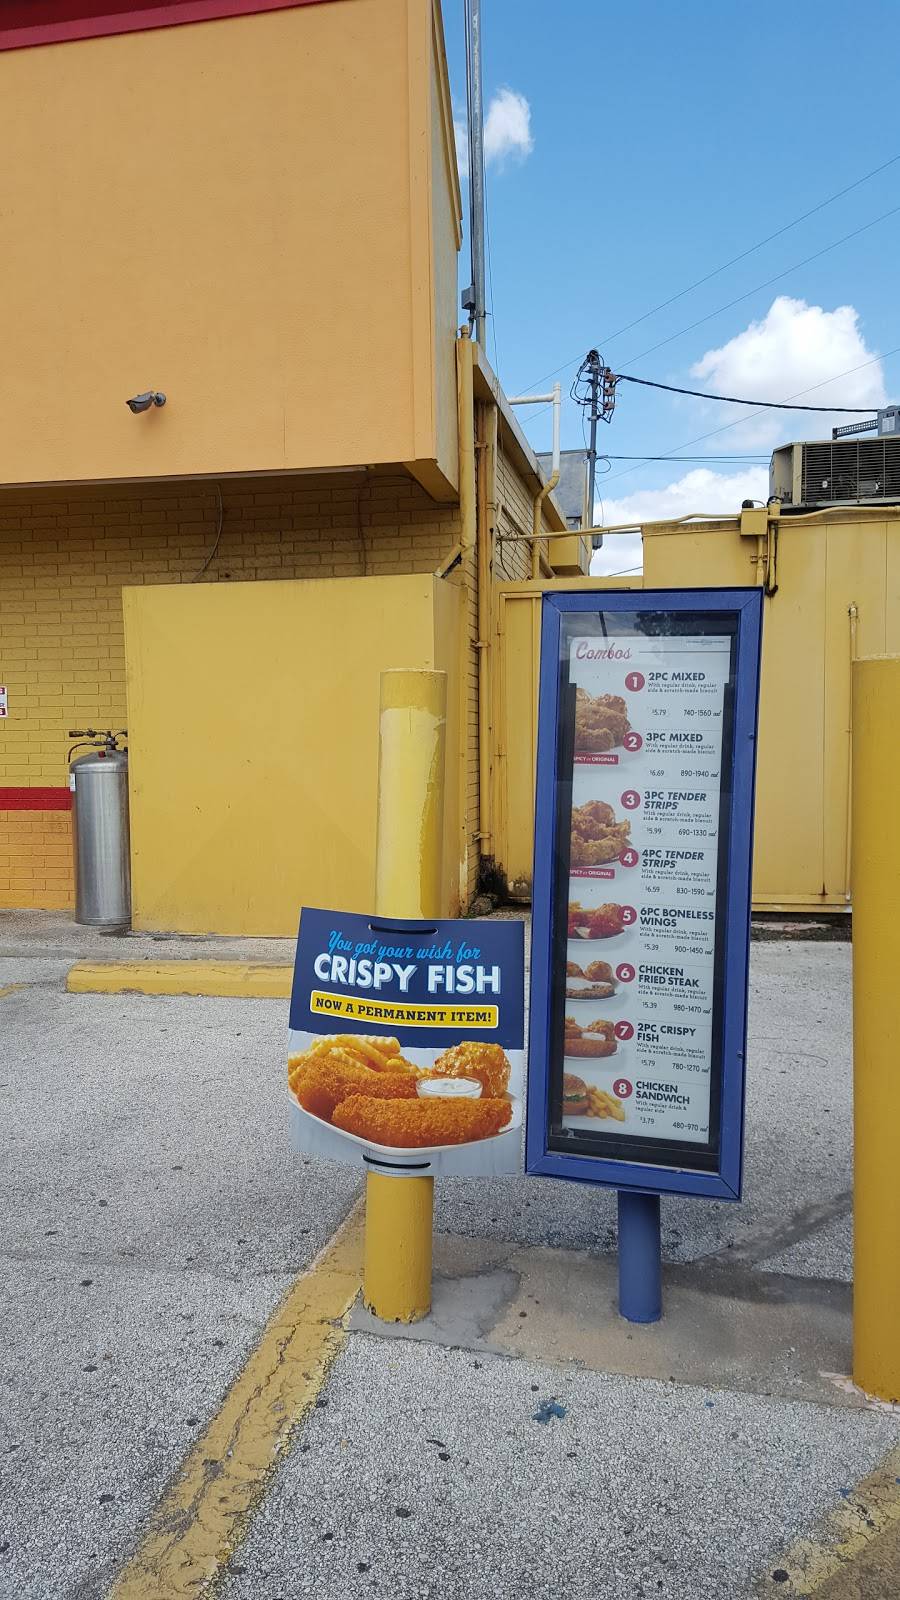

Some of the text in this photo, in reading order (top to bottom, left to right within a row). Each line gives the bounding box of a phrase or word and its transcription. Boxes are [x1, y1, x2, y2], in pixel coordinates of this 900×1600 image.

[576, 640, 632, 660] Combos
[632, 676, 637, 688] 1
[629, 737, 637, 748] 2
[646, 733, 703, 742] 3PC MIXED
[626, 794, 635, 805] 3
[668, 792, 706, 801] TENDER
[624, 853, 632, 863] 4
[666, 851, 704, 860] TENDER
[623, 911, 631, 921] 5
[641, 908, 714, 920] 6PC BONELESS
[640, 917, 677, 927] WINGS
[328, 931, 481, 963] You got your wish for
[675, 946, 703, 954] 900-1450
[314, 954, 500, 994] CRISPY FISH
[621, 968, 630, 978] 6
[639, 965, 683, 976] CHICKEN
[639, 975, 699, 987] FRIED STEAK
[316, 998, 492, 1022] NOW A PERMANENT ITEM!
[674, 1004, 701, 1013] 980-1470
[619, 1026, 628, 1036] 7
[638, 1023, 696, 1036] 2PC CRISPY
[638, 1033, 659, 1042] FISH
[672, 1063, 700, 1072] 780-1270
[619, 1083, 627, 1094] 8
[636, 1081, 678, 1093] CHICKEN
[636, 1091, 690, 1104] SANDWICH
[673, 1123, 698, 1131] 480-970
